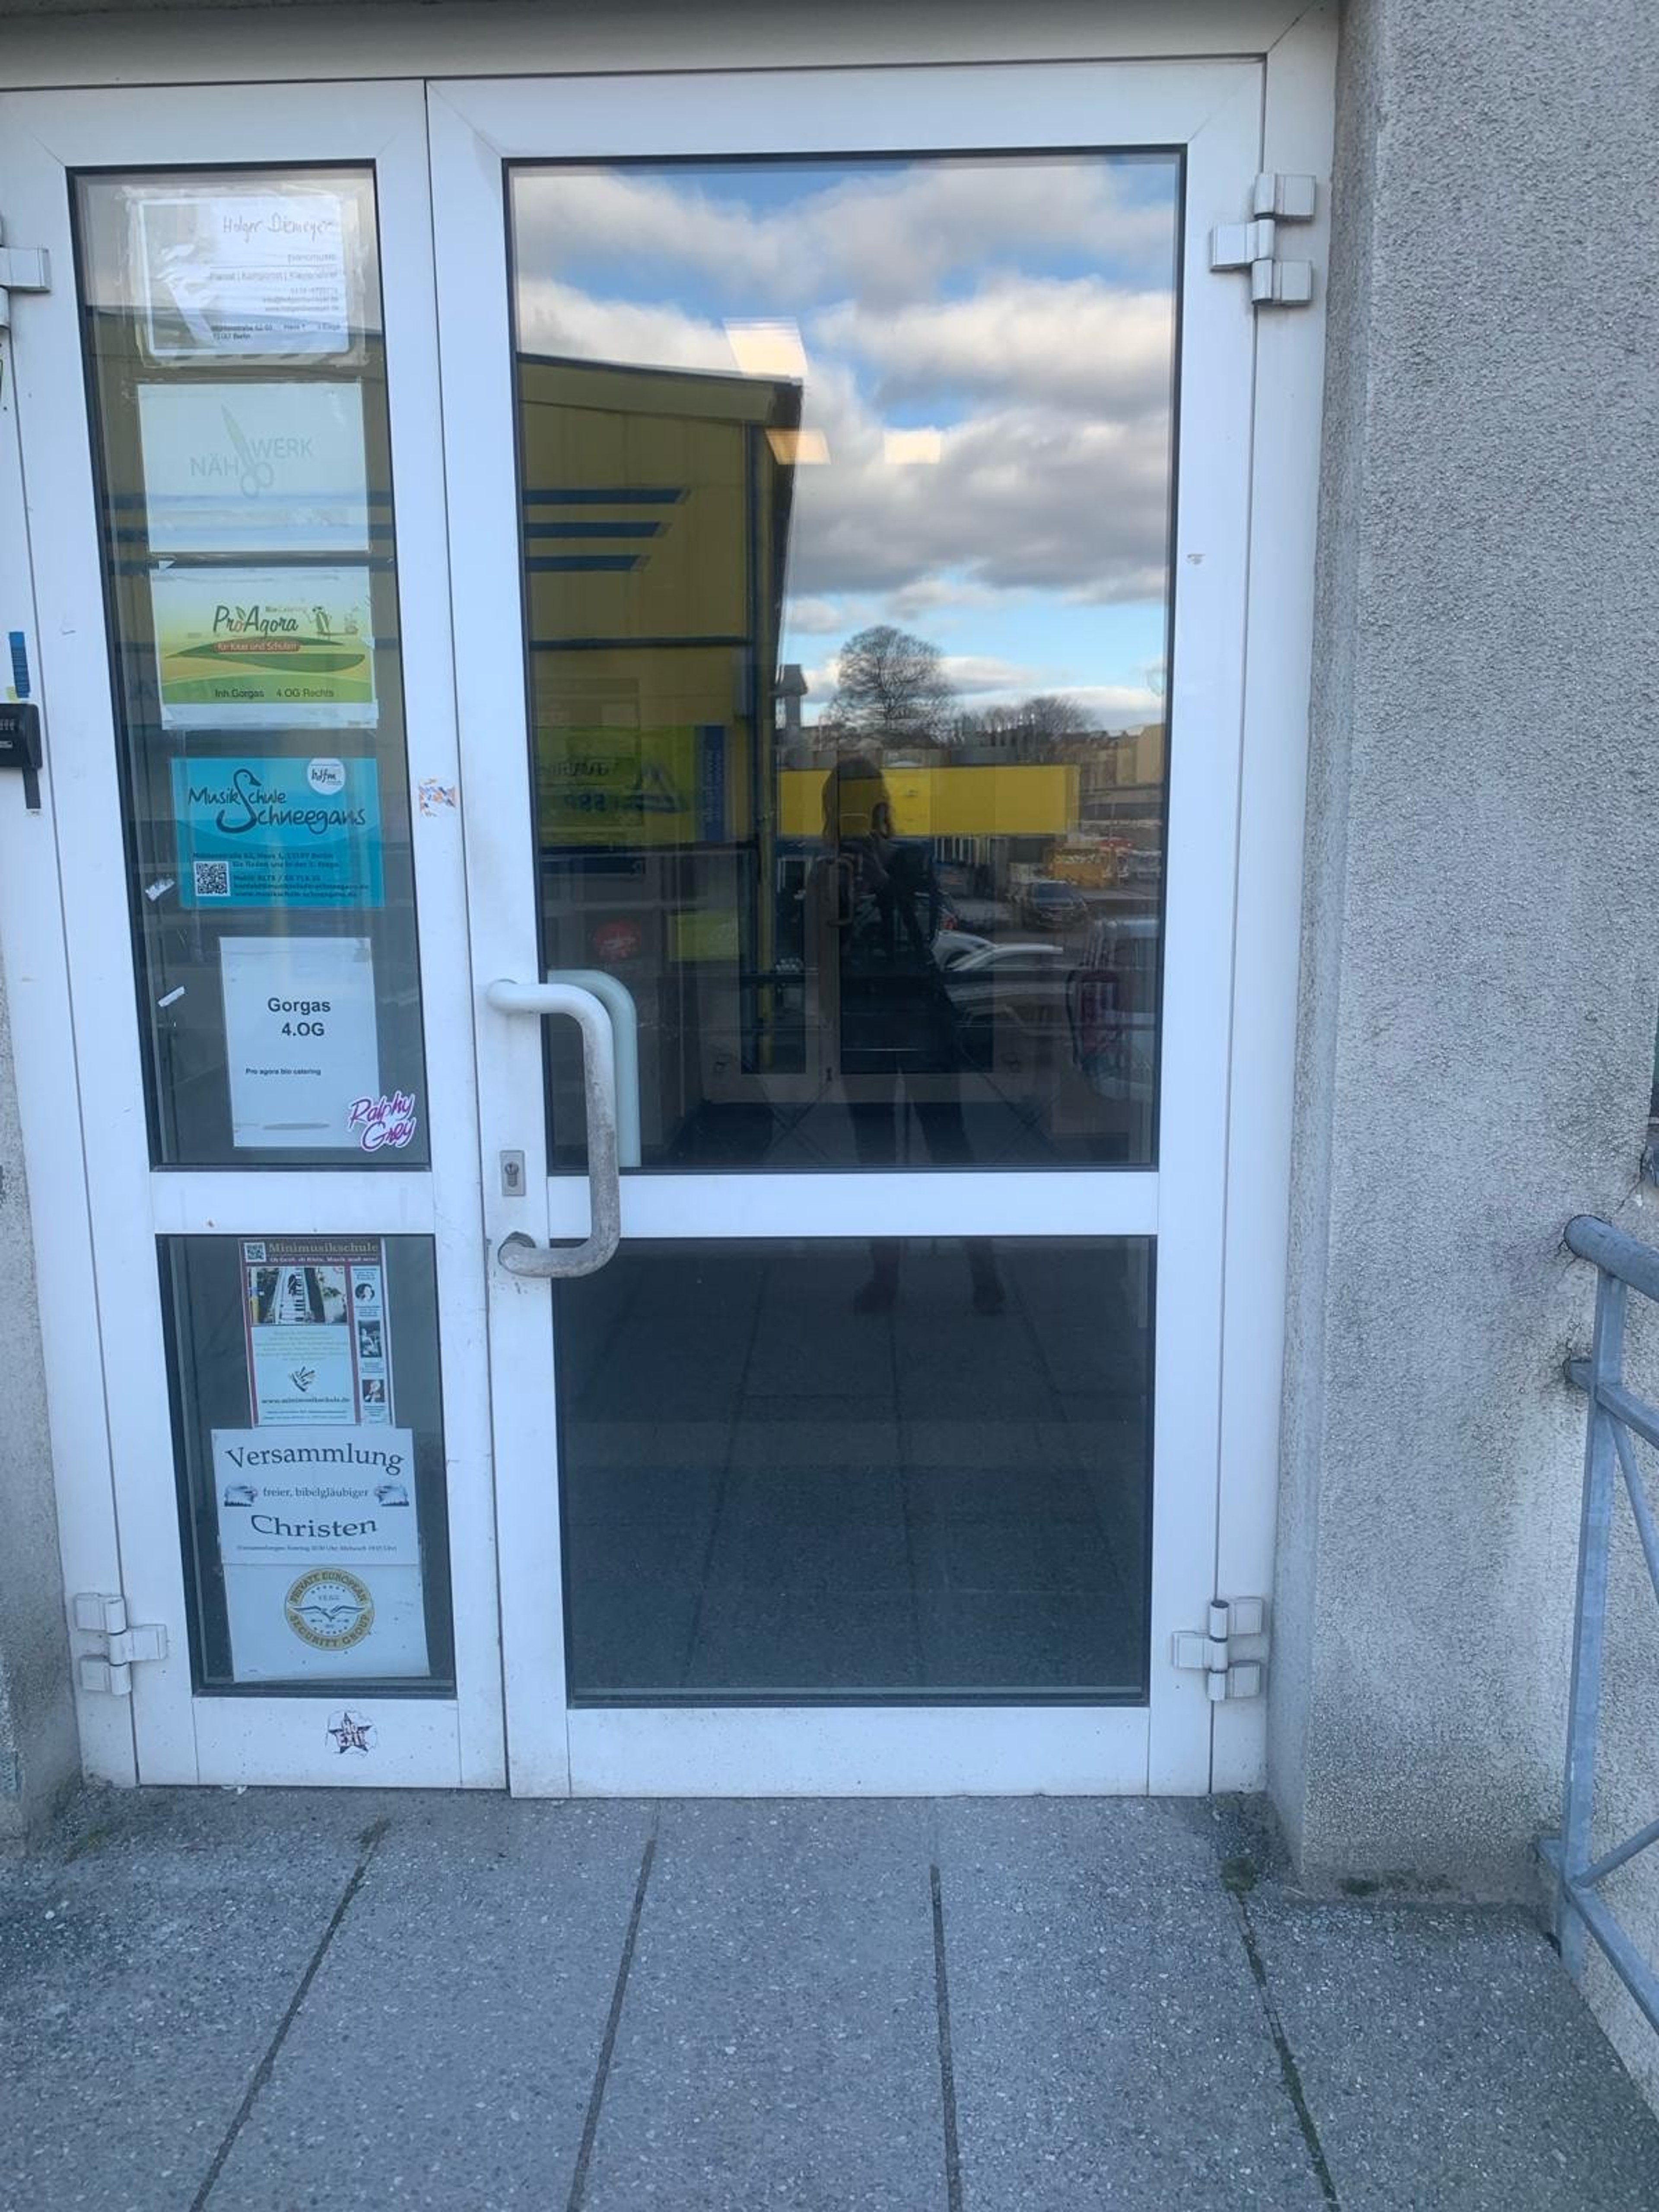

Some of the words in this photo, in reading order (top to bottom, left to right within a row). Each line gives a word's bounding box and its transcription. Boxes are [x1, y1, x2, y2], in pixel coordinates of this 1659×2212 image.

[190, 453, 238, 476] NÄH
[251, 437, 313, 459] WERK
[268, 997, 331, 1015] Gorgas
[282, 1022, 325, 1037] 4.OG
[225, 1443, 405, 1476] Versammlung
[263, 1487, 293, 1498] freier,
[296, 1486, 369, 1499] bibelgläubiger
[251, 1515, 377, 1538] Christen
